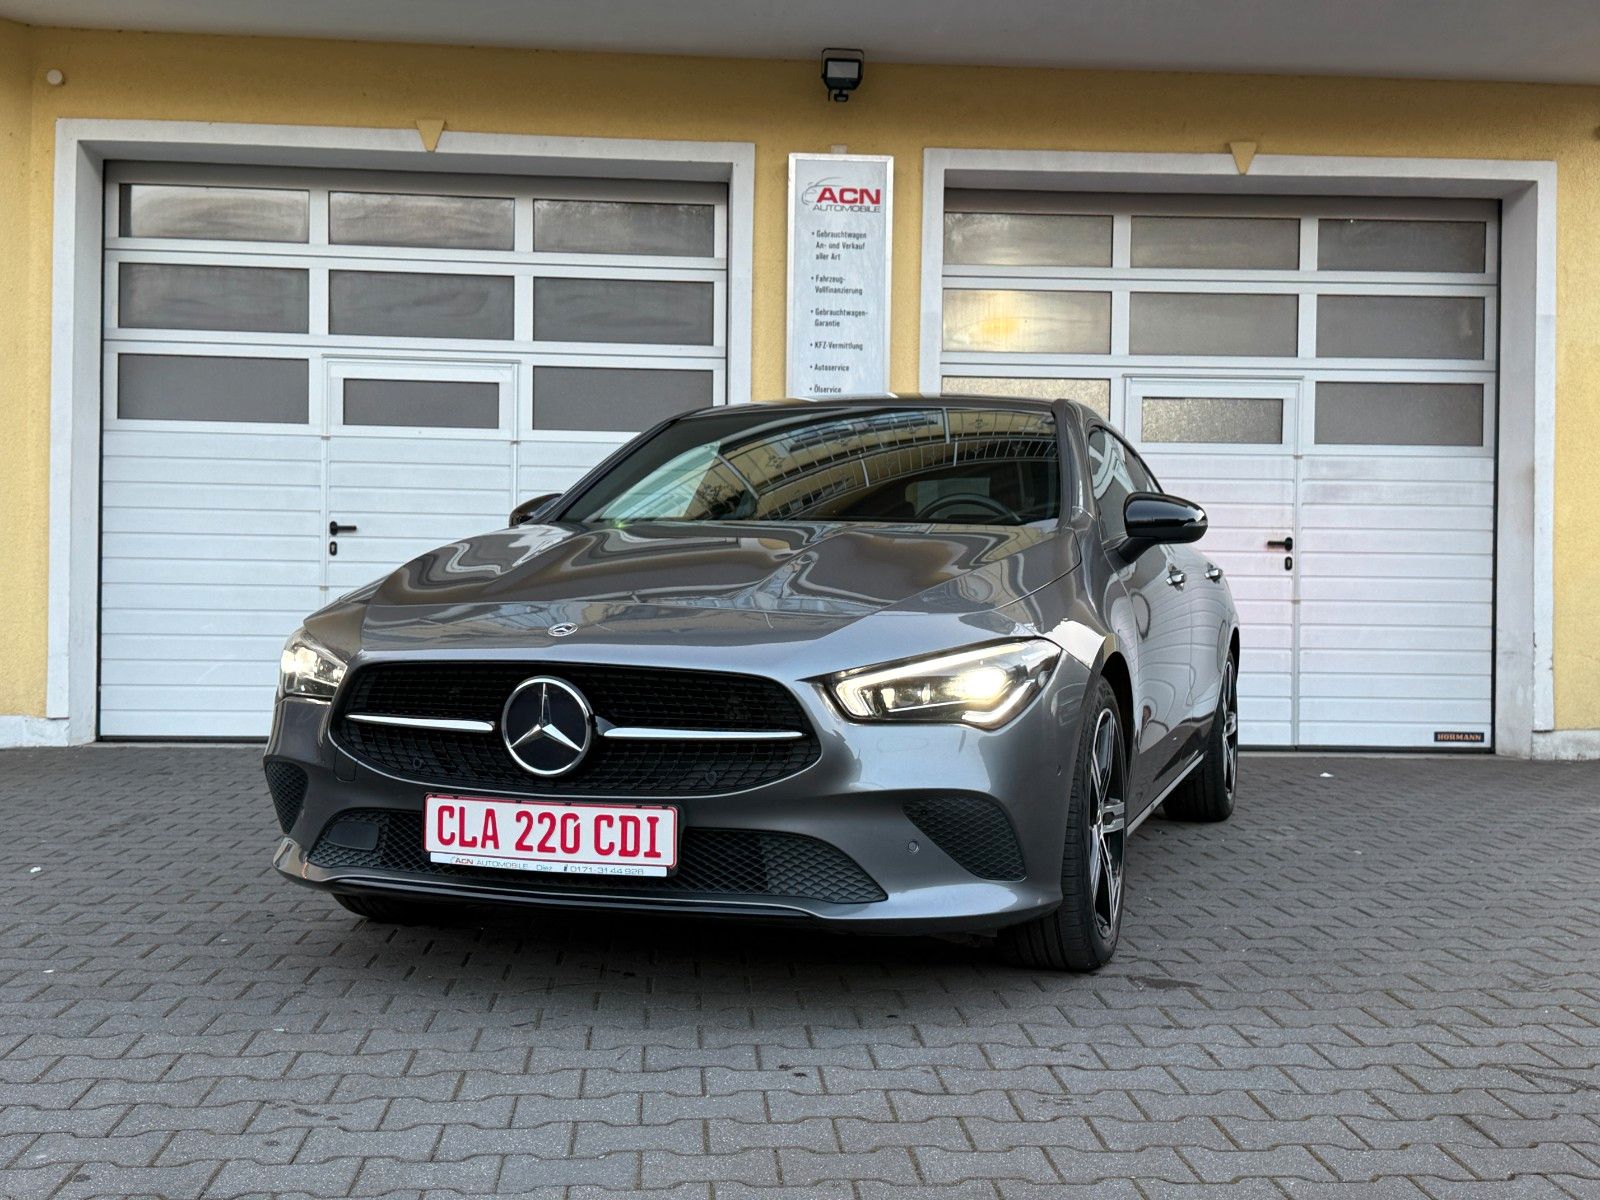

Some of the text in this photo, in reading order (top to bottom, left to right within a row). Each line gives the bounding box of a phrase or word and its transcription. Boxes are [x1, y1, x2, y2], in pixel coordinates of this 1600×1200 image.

[816, 187, 881, 205] ACN
[812, 204, 881, 213] AUTOMOBILE
[816, 230, 867, 240] Gebrauchtwagen
[842, 242, 866, 250] Verkauf
[815, 274, 846, 284] Fahrzeug-
[815, 286, 863, 295] Vollfinanzierung
[815, 308, 868, 318] Gebrauchtwagen-
[814, 319, 841, 327] Garantie
[814, 342, 864, 351] KFZ-Vermittlung
[814, 363, 850, 371] Autoservice
[813, 384, 842, 393] Ölservice
[437, 805, 661, 859] CLA 220 CDI
[455, 857, 474, 865] ACN
[476, 860, 529, 870] AUTOMOBILE
